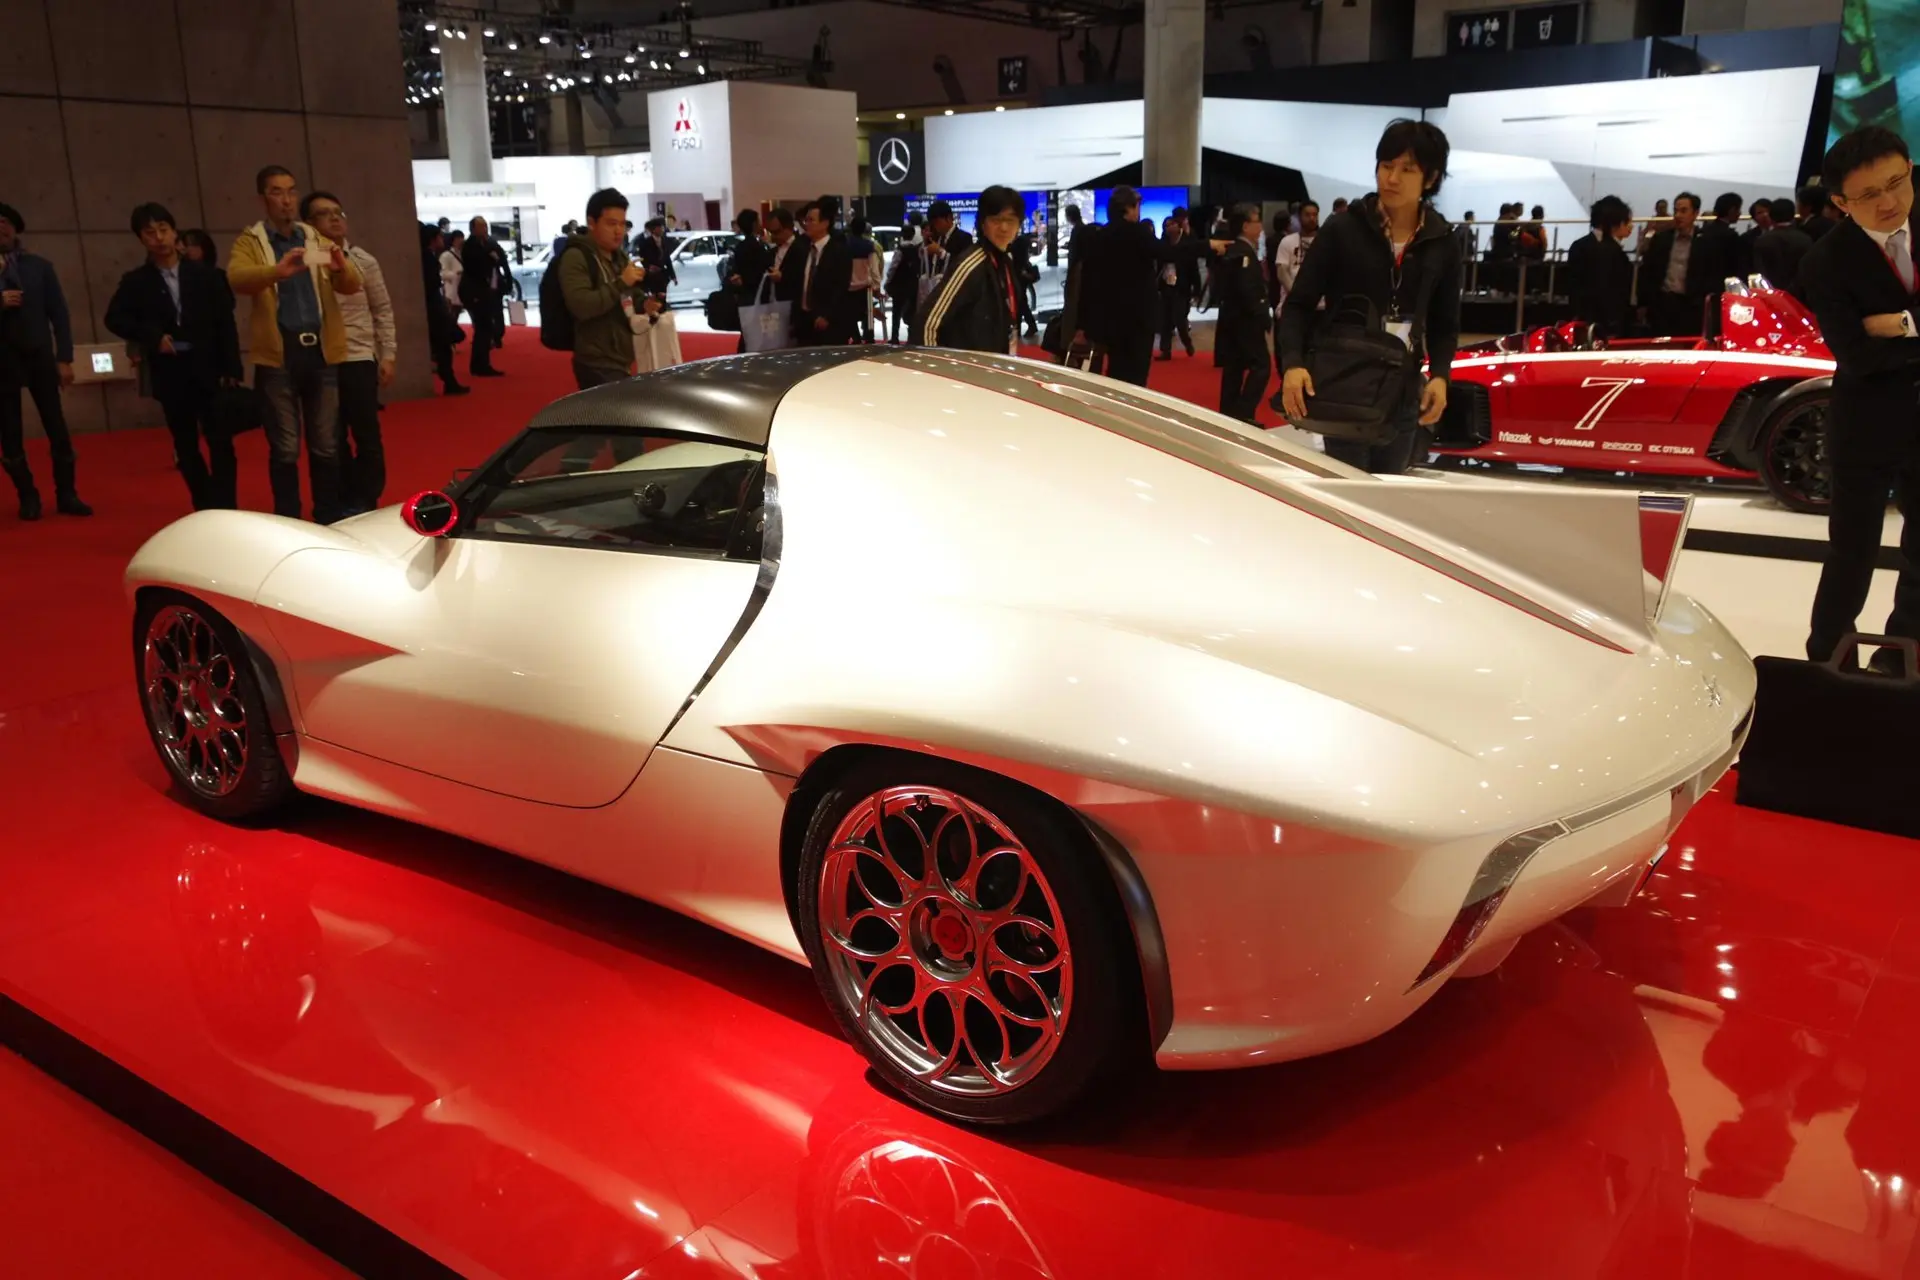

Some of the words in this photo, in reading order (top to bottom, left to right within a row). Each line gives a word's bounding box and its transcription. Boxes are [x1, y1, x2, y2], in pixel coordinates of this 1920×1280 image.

[672, 137, 696, 149] FUSO
[1574, 377, 1633, 430] 7
[1499, 431, 1532, 444] Mazak
[1554, 438, 1595, 448] YANMAR
